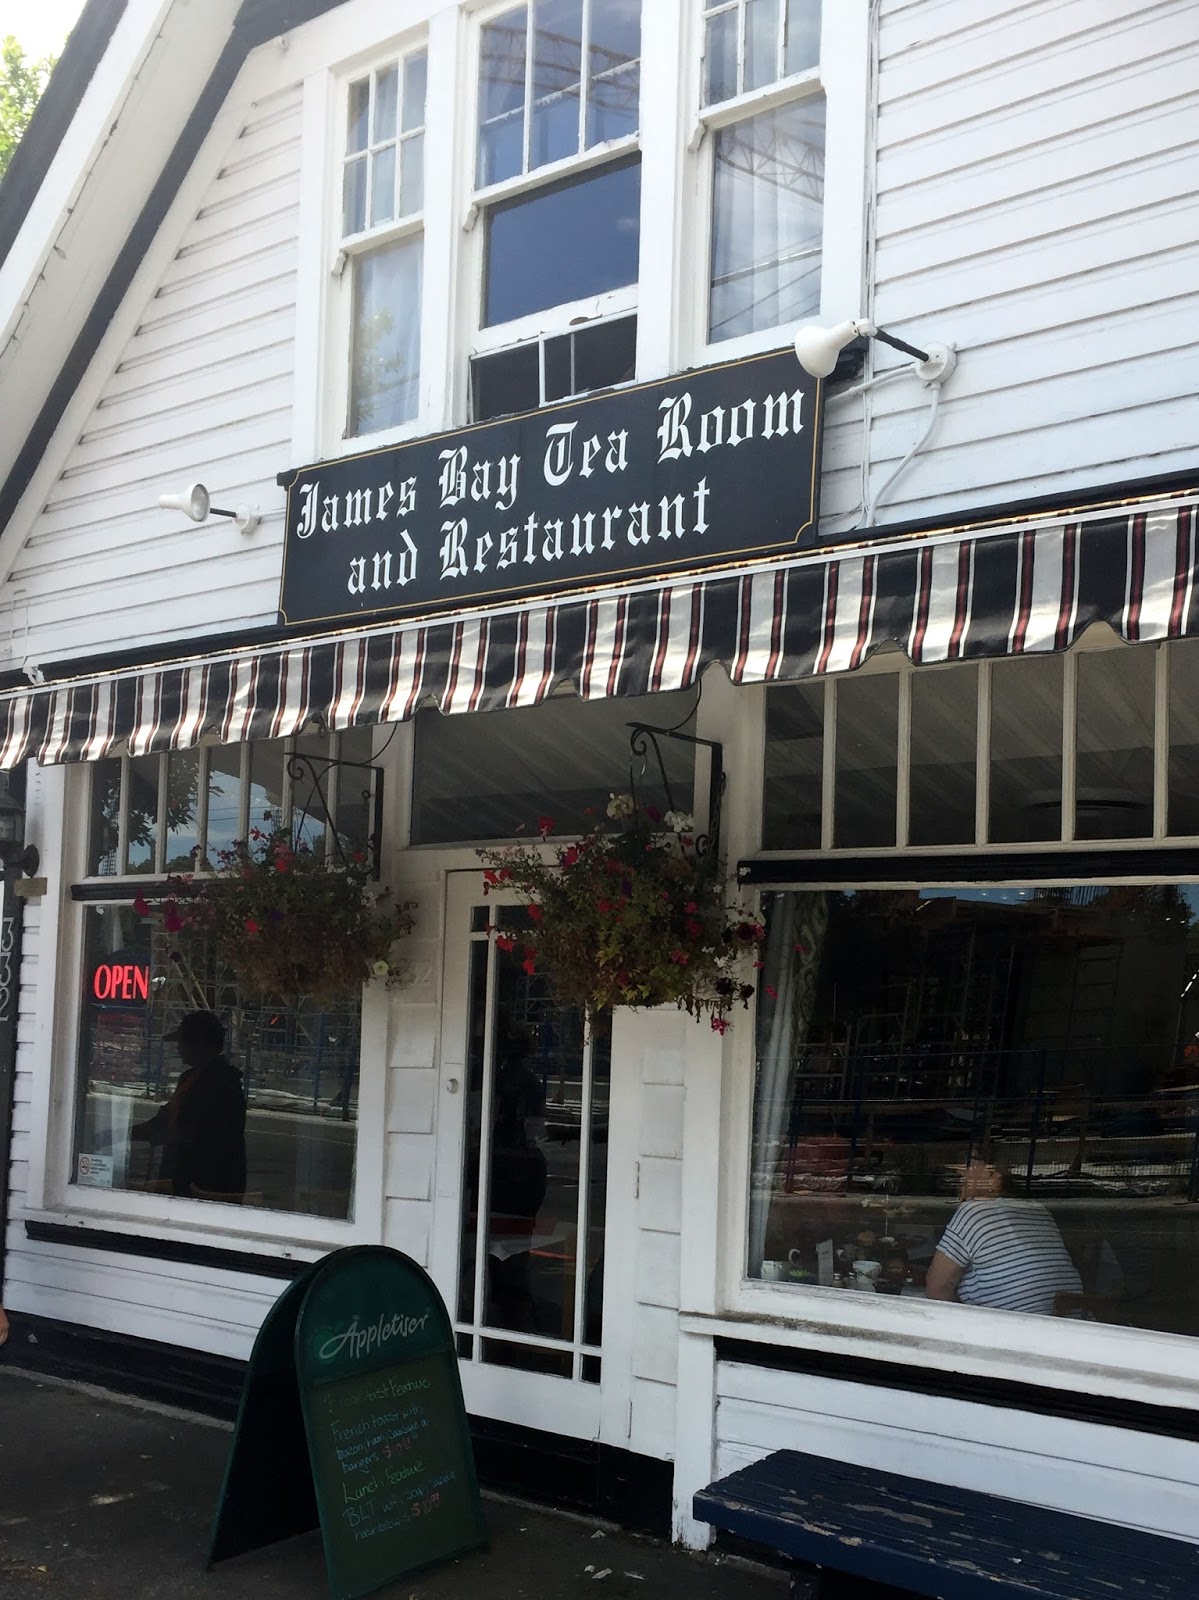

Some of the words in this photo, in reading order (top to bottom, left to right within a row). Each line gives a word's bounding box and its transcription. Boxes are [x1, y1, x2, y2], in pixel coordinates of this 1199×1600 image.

[296, 476, 417, 540] James
[438, 445, 521, 511] Bay
[543, 420, 629, 487] Tea
[657, 388, 805, 466] Room
[347, 529, 418, 595] and
[439, 476, 711, 581] Restaurant
[94, 964, 149, 999] OPEN
[318, 1312, 429, 1360] Appletiser
[331, 1415, 371, 1441] French
[342, 1475, 385, 1504] Lunch
[342, 1496, 377, 1528] BLT
